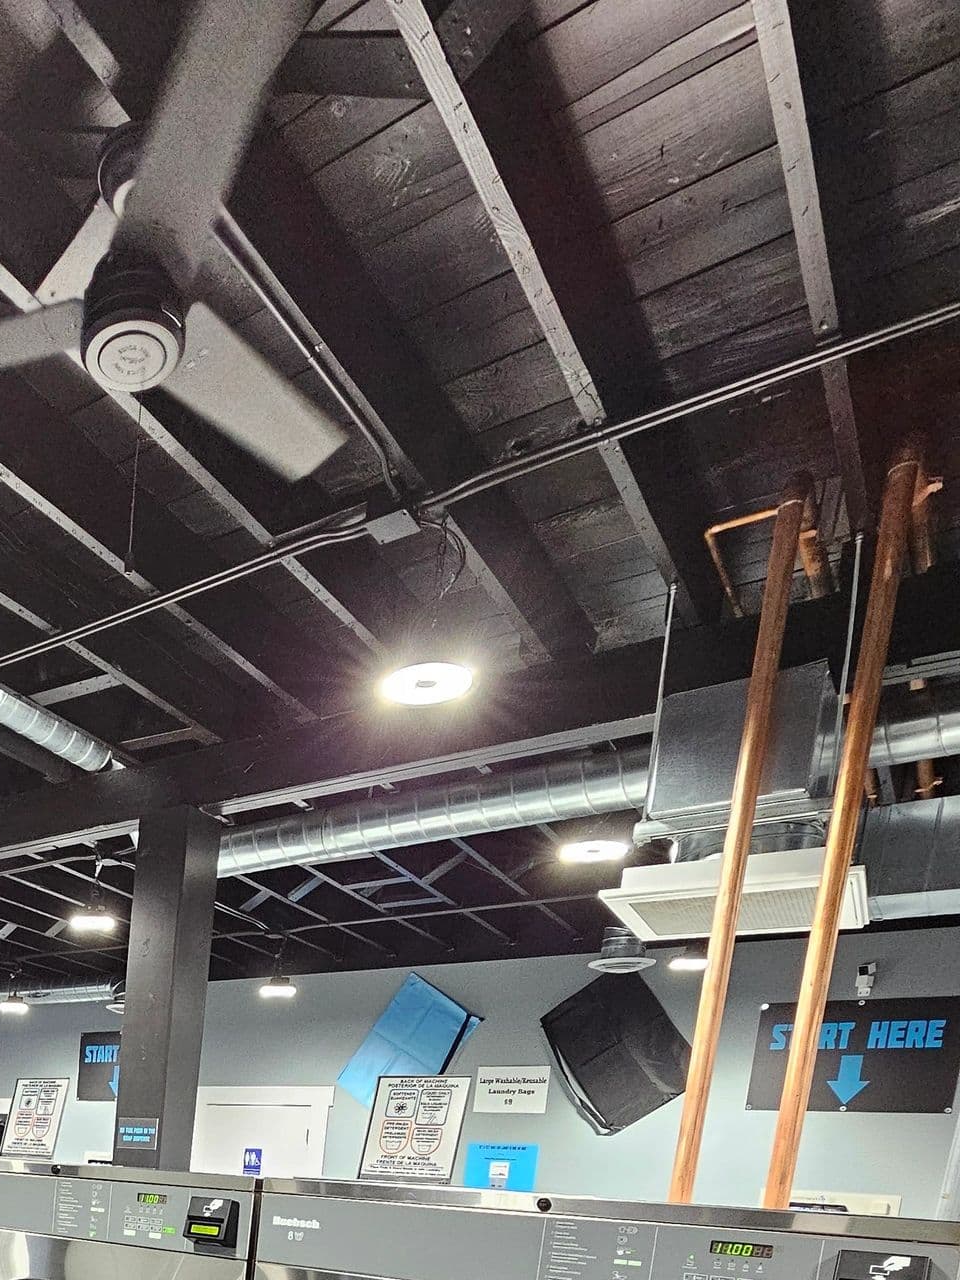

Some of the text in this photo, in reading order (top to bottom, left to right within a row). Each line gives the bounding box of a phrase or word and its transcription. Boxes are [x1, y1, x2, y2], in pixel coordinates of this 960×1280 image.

[769, 1020, 946, 1050] SRT HERE
[84, 1044, 120, 1063] START
[479, 1077, 494, 1086] Large
[488, 1088, 535, 1096] Laundry Bags
